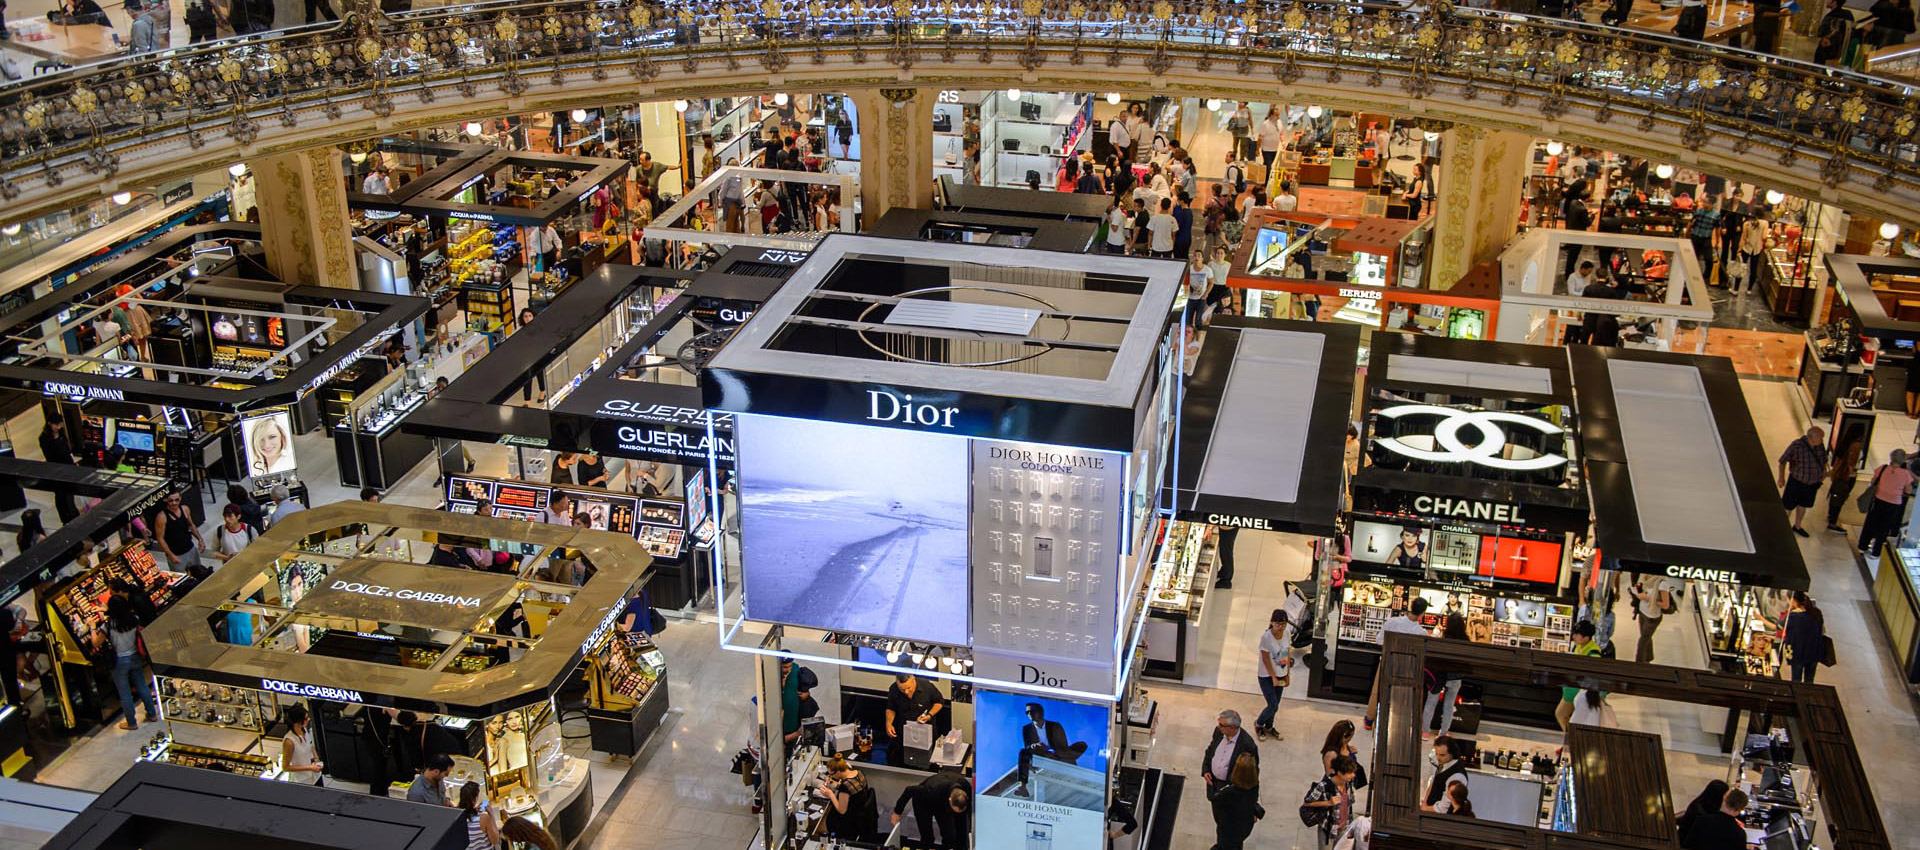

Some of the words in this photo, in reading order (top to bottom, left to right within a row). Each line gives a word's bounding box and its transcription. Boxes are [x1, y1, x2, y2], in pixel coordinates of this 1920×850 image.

[313, 364, 339, 389] GIORGIO
[44, 381, 85, 396] GIORGIO
[87, 386, 125, 401] ARMANI
[866, 389, 960, 428] Dior
[617, 426, 734, 454] GUERLAIN
[618, 443, 647, 453] MAISON
[647, 446, 677, 456] FONDÉE
[684, 451, 706, 459] PARIS
[989, 446, 1032, 463] DIOR
[1038, 451, 1105, 470] HOMME
[1021, 461, 1073, 474] COLOGNE
[1414, 495, 1526, 524] CHANEL
[1208, 513, 1273, 530] CHANEL
[1441, 524, 1473, 534] CHANEL
[1666, 565, 1741, 584] CHANEL
[1017, 664, 1068, 689] Dior
[1007, 801, 1032, 811] DIOR
[1034, 804, 1073, 817] HOMME
[1018, 811, 1063, 822] COLOGNE
